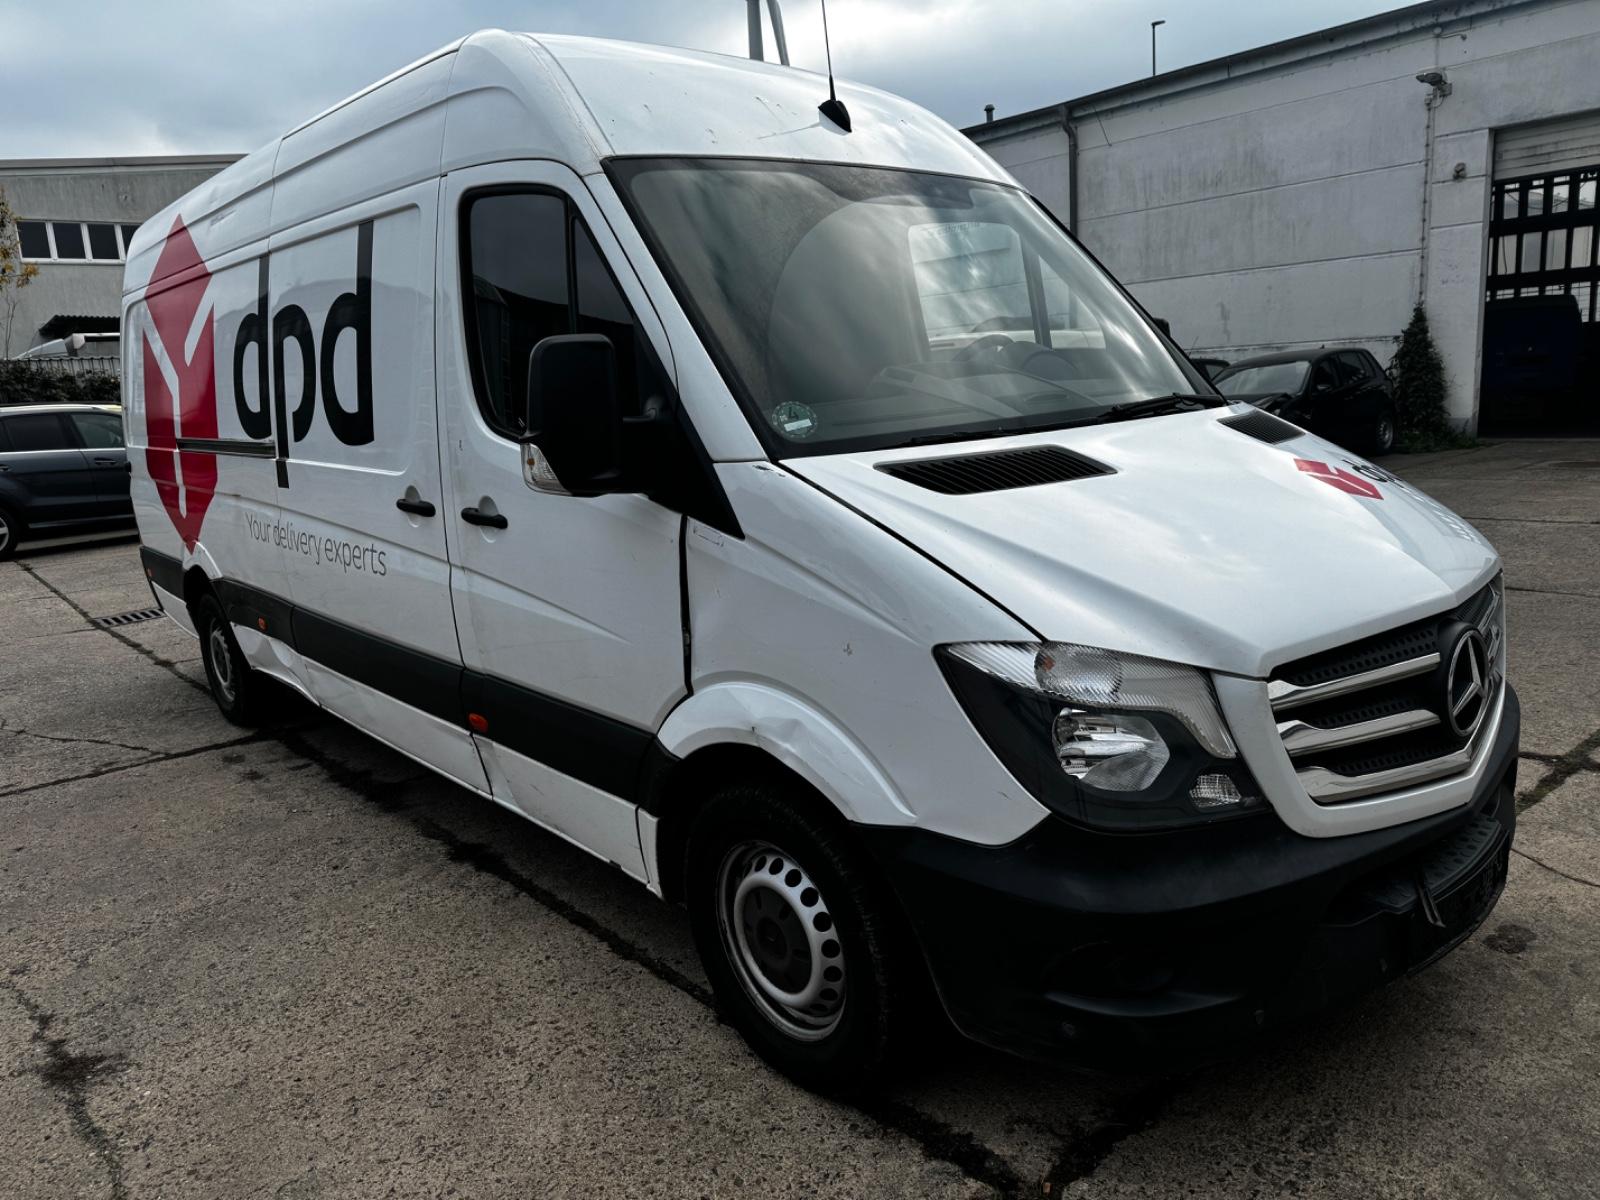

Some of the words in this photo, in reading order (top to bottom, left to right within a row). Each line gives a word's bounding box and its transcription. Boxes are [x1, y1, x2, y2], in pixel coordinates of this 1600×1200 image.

[233, 219, 375, 489] dpd
[246, 512, 271, 543] Your
[273, 519, 323, 565] delivery
[324, 537, 387, 576] experts
